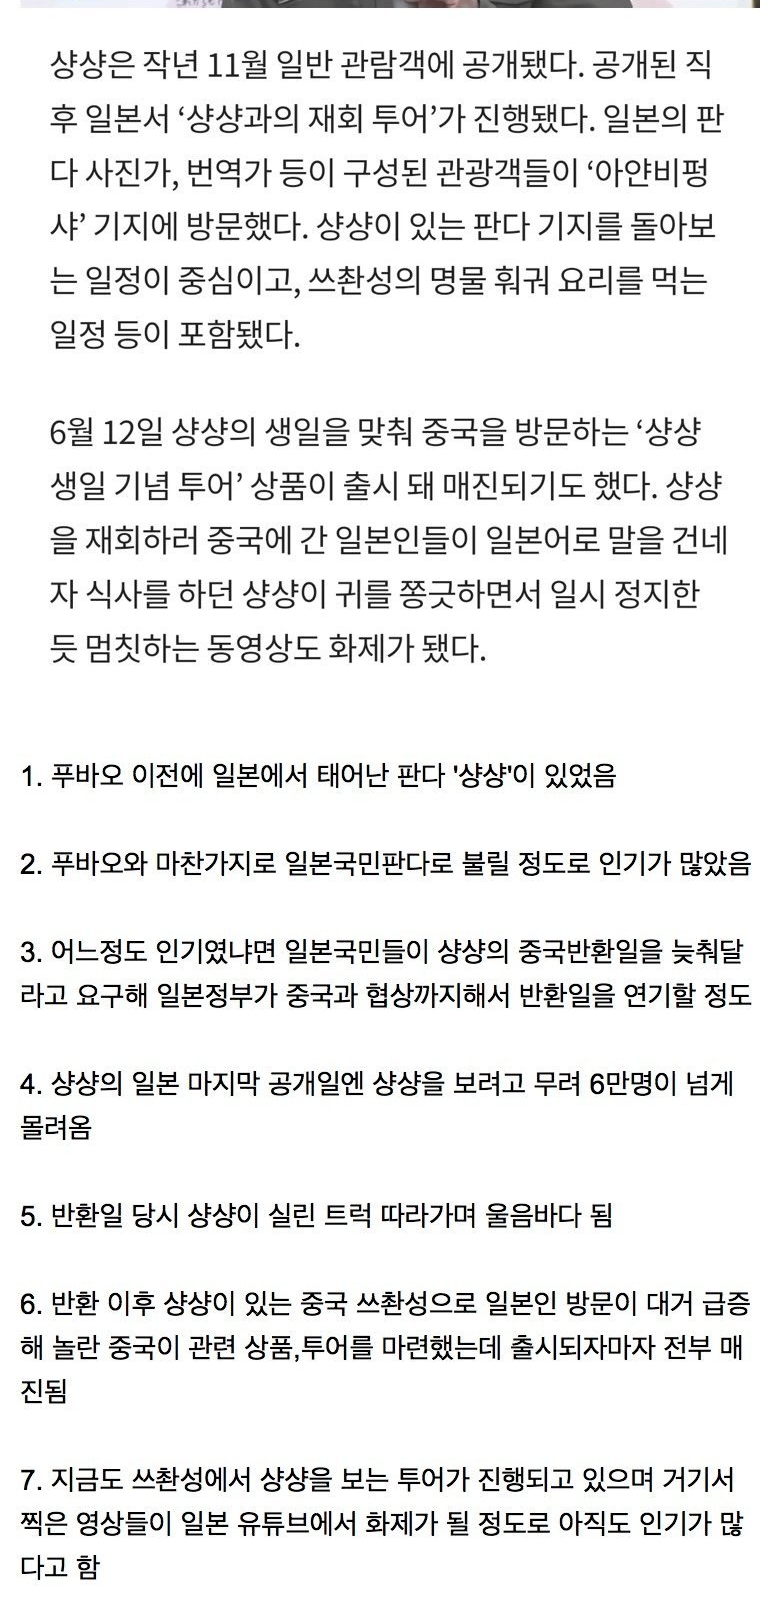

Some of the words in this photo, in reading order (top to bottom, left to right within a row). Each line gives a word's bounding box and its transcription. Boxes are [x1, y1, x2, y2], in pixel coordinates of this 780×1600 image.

[50, 49, 136, 80] 샹샹은
[143, 49, 198, 80] 작년
[208, 49, 268, 80] 11월
[277, 49, 334, 80] 일반
[340, 49, 454, 80] 관람객에
[462, 49, 584, 80] 공개됐다.
[592, 49, 676, 80] 공개된
[686, 49, 711, 80] 직
[22, 764, 42, 787] 1.
[51, 762, 124, 789] 푸바오
[132, 762, 203, 789] 이전에
[213, 762, 307, 789] 일본에서
[317, 762, 390, 789] 태어난
[397, 762, 446, 789] 판다
[545, 762, 617, 789] 있었음
[20, 1114, 92, 1141] 몰려옴
[20, 1205, 42, 1227] 5.
[52, 1202, 123, 1228] 반환일
[132, 1202, 178, 1229] 당시
[187, 1202, 258, 1229] 샹샹이
[268, 1202, 315, 1229] 실린
[324, 1202, 371, 1229] 트럭
[381, 1202, 475, 1229] 따라가며
[485, 1202, 583, 1229] 울음바다
[590, 1202, 612, 1228] 됨
[20, 1378, 66, 1405] 진됨
[21, 1554, 68, 1581] 다고
[76, 1554, 101, 1581] 함
